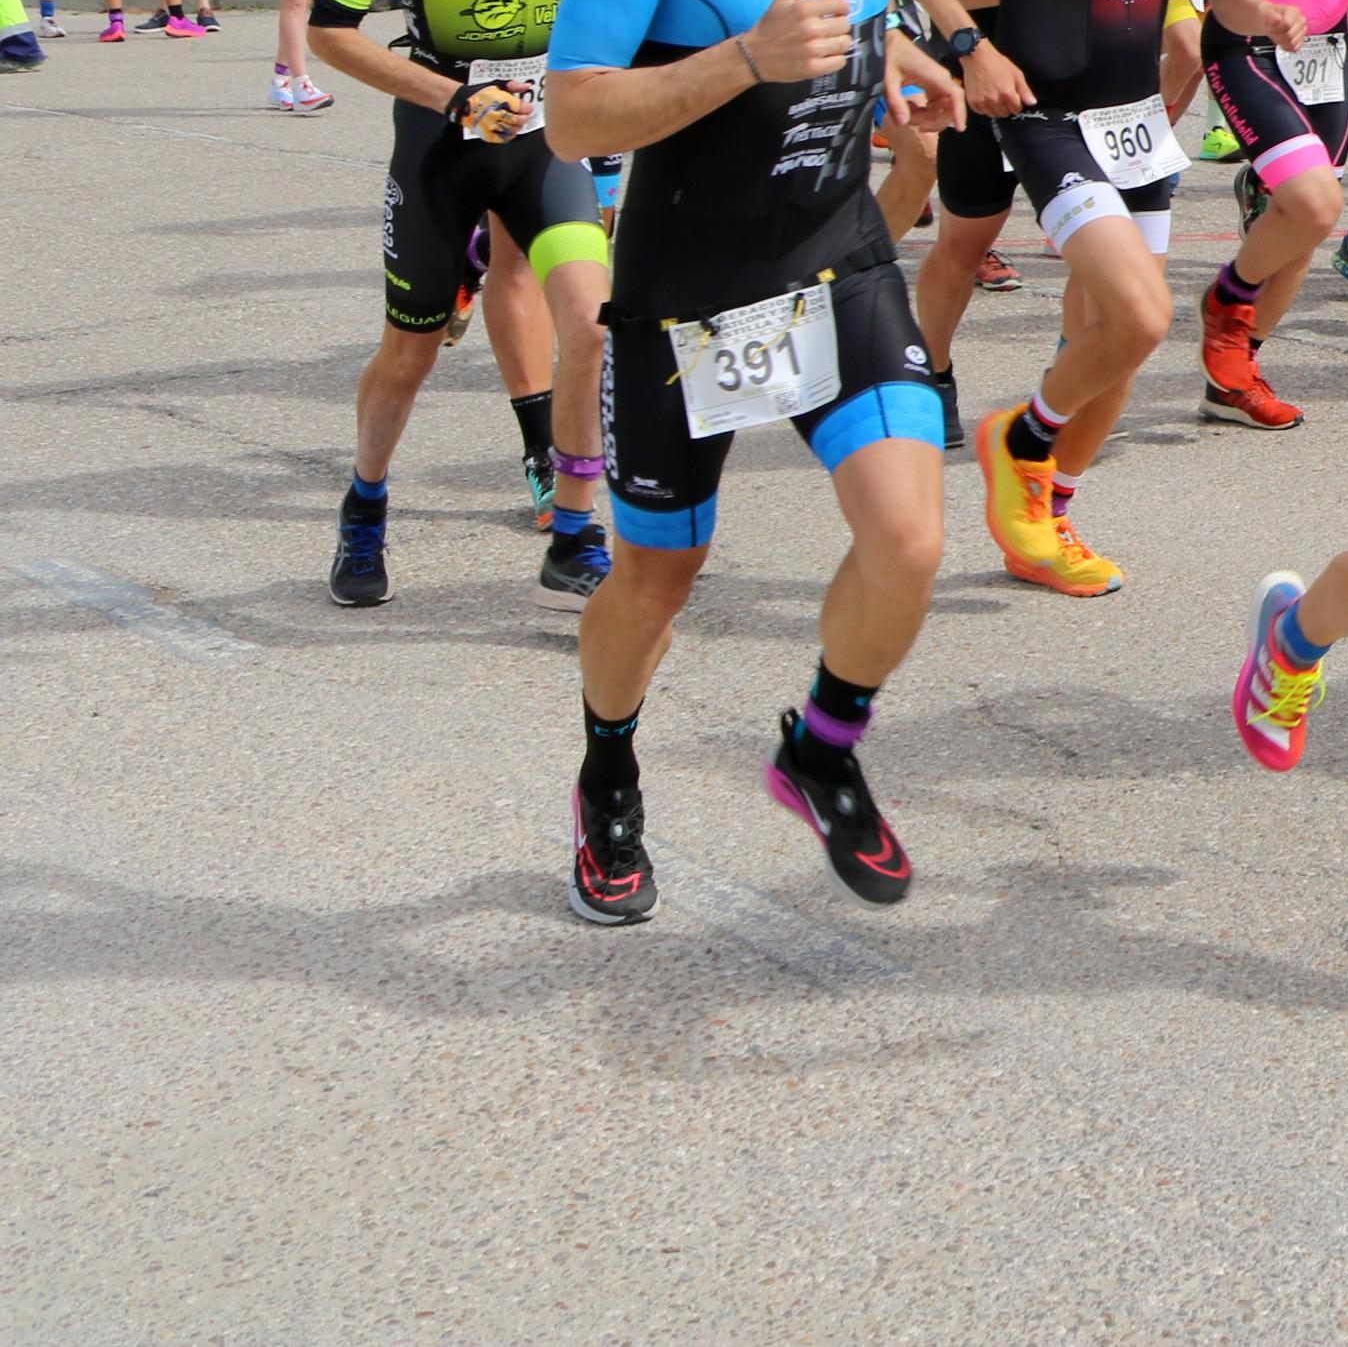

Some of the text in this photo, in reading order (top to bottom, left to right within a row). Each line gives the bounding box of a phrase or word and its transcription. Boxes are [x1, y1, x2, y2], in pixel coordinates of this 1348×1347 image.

[457, 25, 526, 41] JOANCA
[1294, 58, 1328, 85] 301
[1104, 122, 1153, 162] 960
[714, 331, 802, 392] 391
